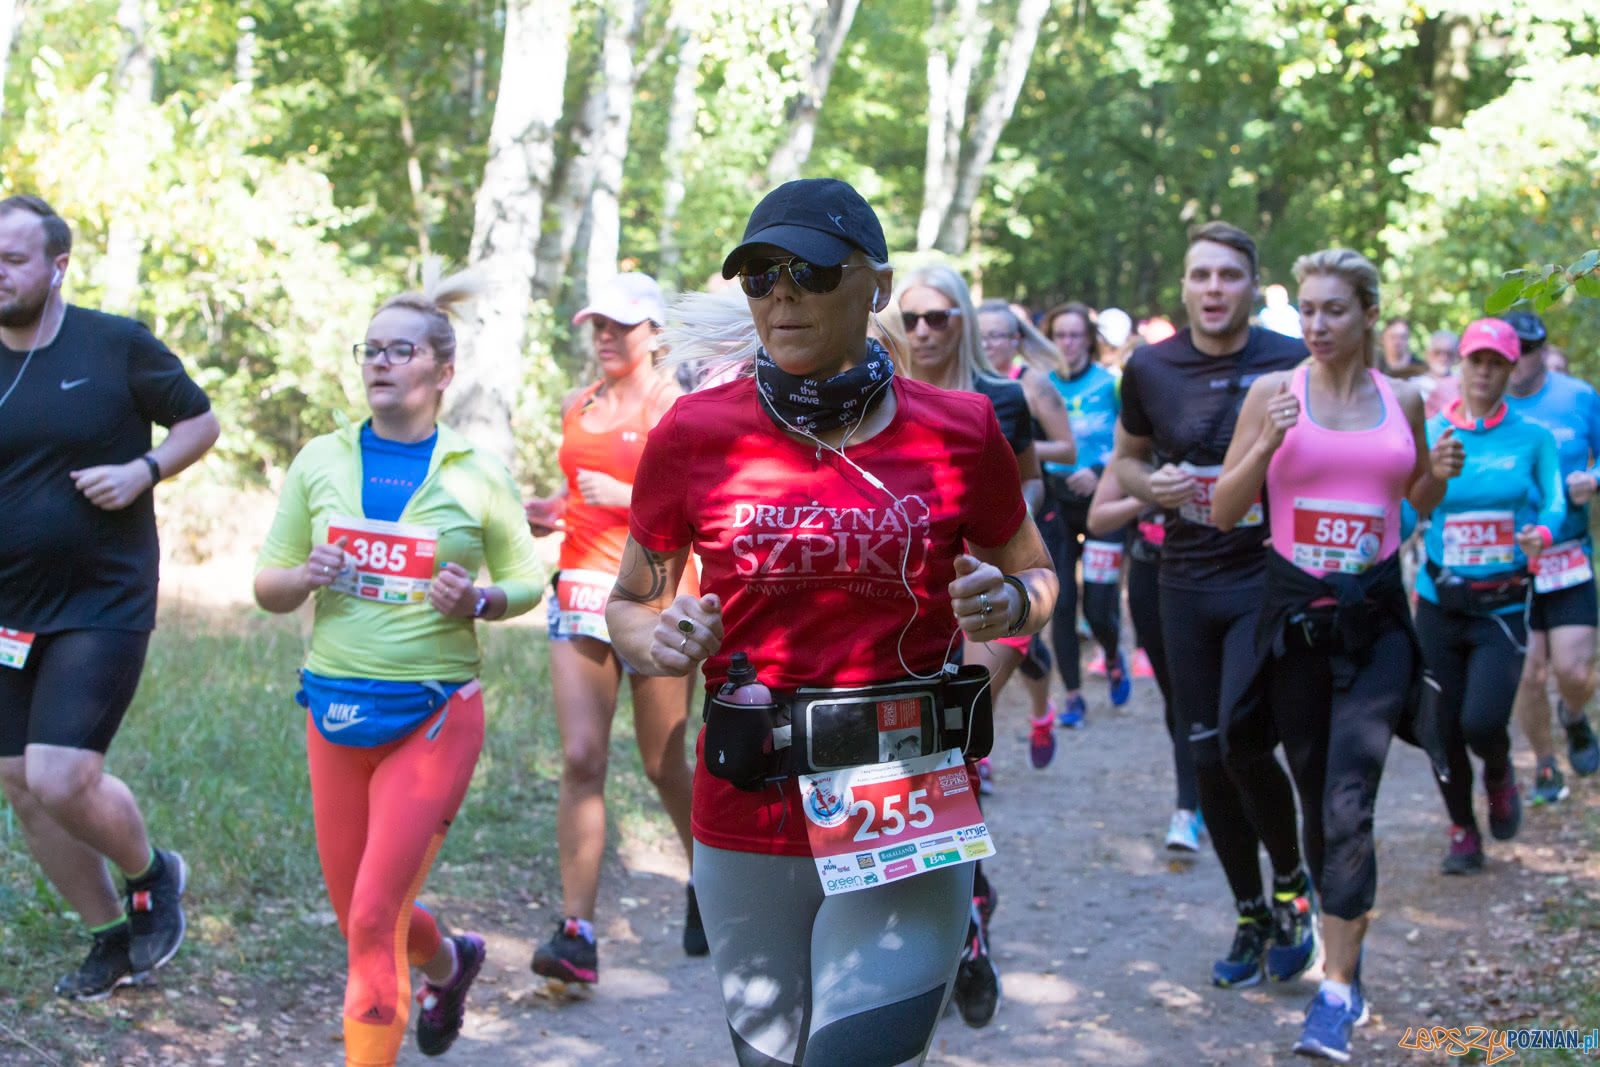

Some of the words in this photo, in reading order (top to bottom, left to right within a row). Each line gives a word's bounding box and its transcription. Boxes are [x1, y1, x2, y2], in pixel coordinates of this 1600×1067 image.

[789, 392, 820, 405] move
[800, 385, 818, 396] the
[843, 399, 857, 409] on
[733, 500, 904, 532] DRUŻYNA
[1315, 517, 1367, 545] 587
[353, 537, 408, 573] 385
[732, 531, 930, 578] SZPIKU
[568, 585, 604, 611] 105
[327, 702, 360, 721] NIKE
[849, 788, 935, 842] 255
[965, 825, 987, 837] mjp
[826, 875, 863, 892] green
